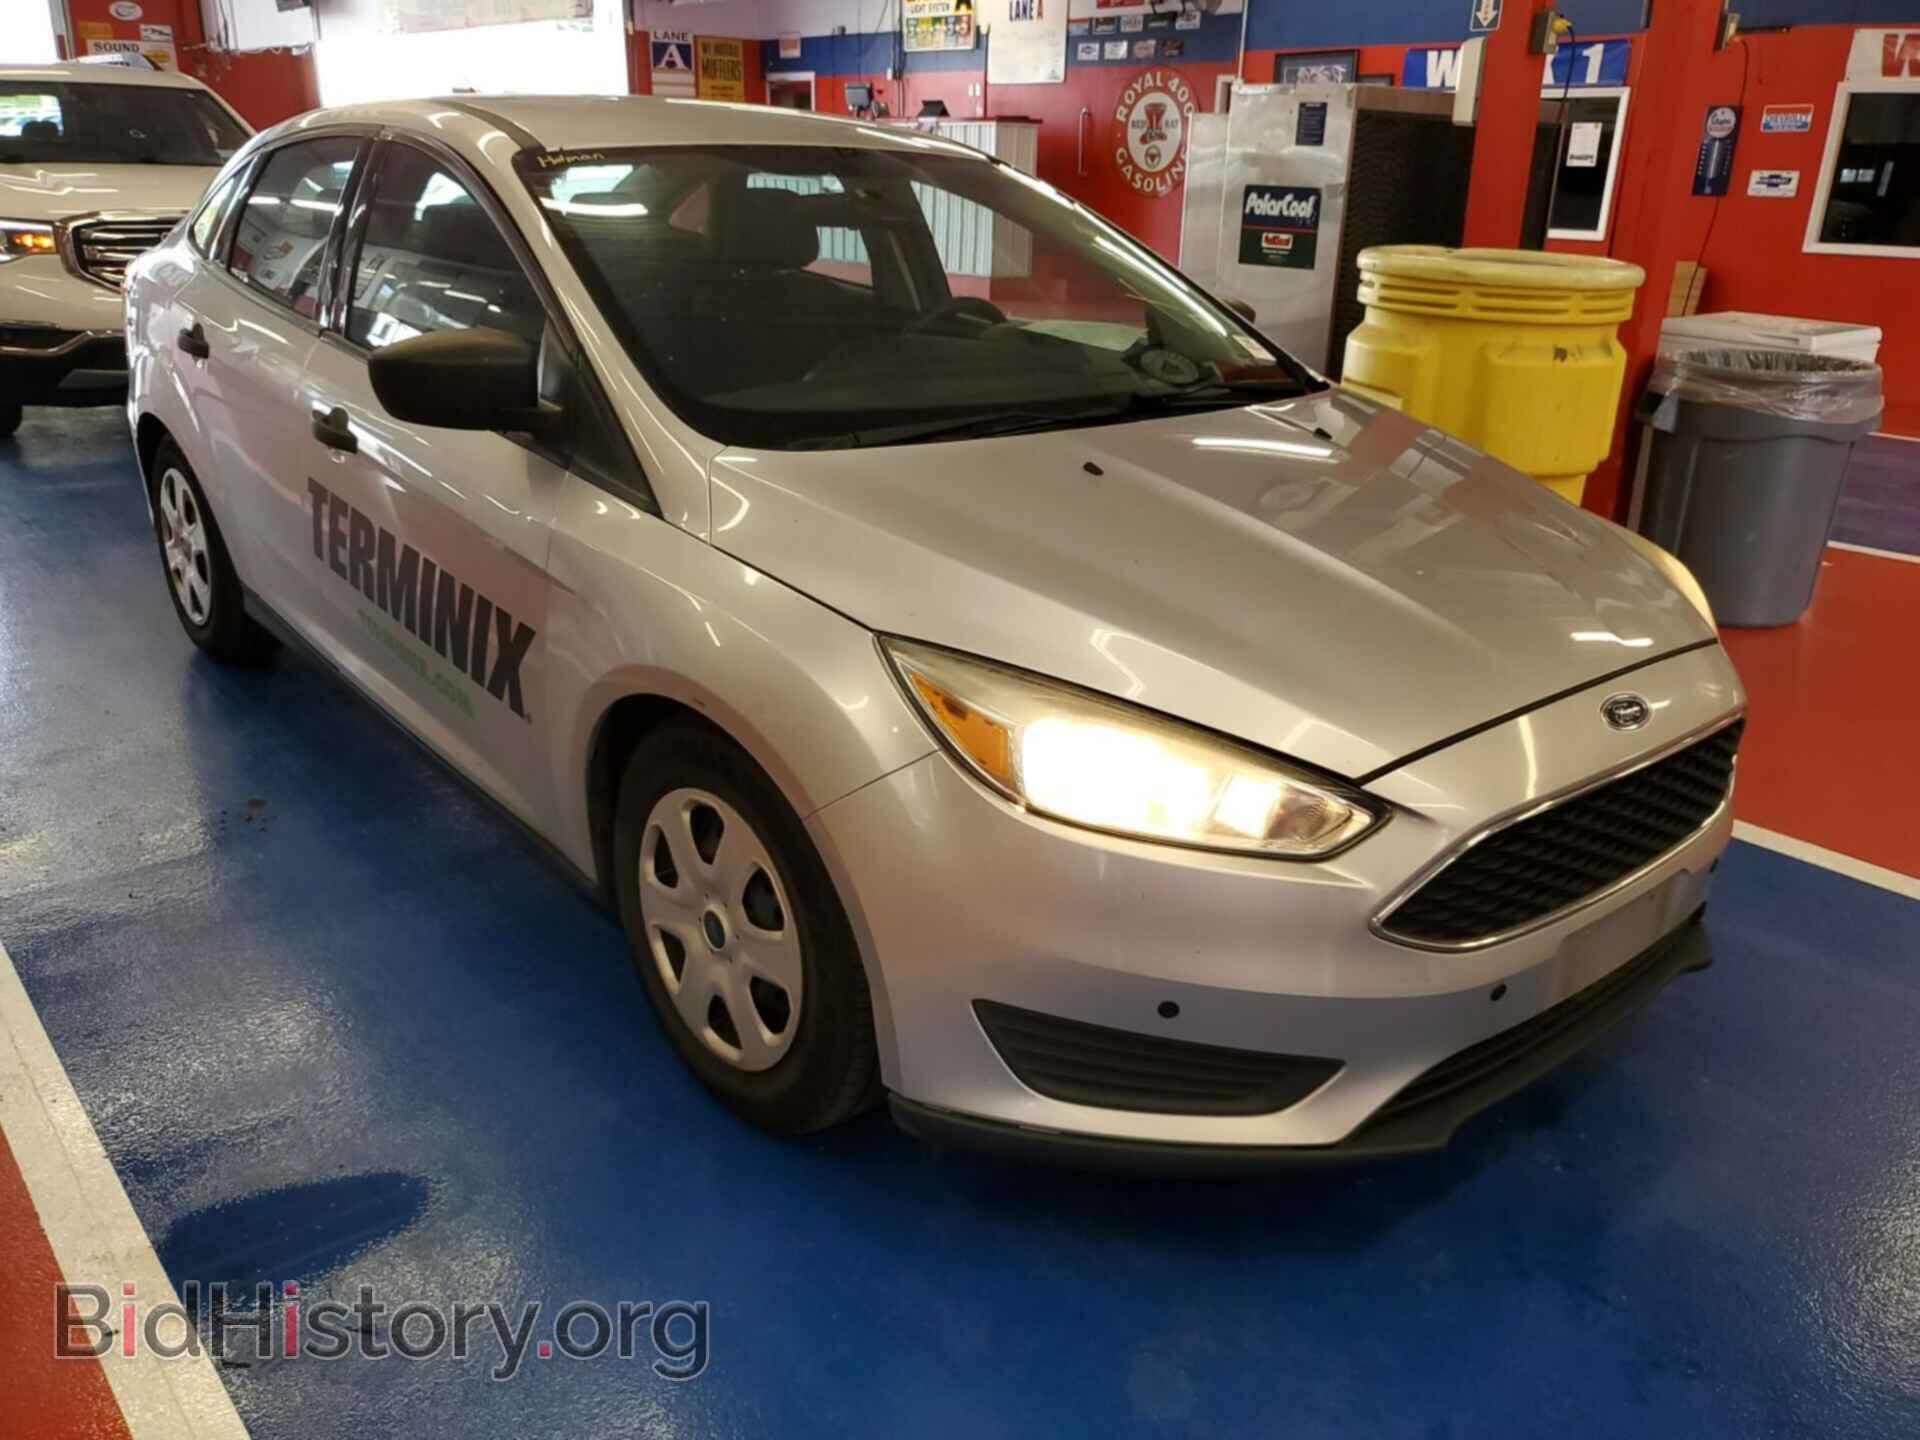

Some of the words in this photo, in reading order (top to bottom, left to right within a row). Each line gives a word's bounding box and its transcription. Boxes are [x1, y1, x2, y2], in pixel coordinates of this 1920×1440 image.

[1009, 0, 1034, 21] LANE
[1036, 0, 1044, 20] A
[93, 41, 140, 53] SOUND
[653, 31, 689, 41] LANE
[659, 44, 689, 69] A
[1582, 43, 1604, 84] 1
[1116, 71, 1164, 122] ROYAL
[1168, 78, 1194, 118] 400
[1244, 192, 1316, 219] PolarCool
[308, 477, 533, 719] TERMINIX
